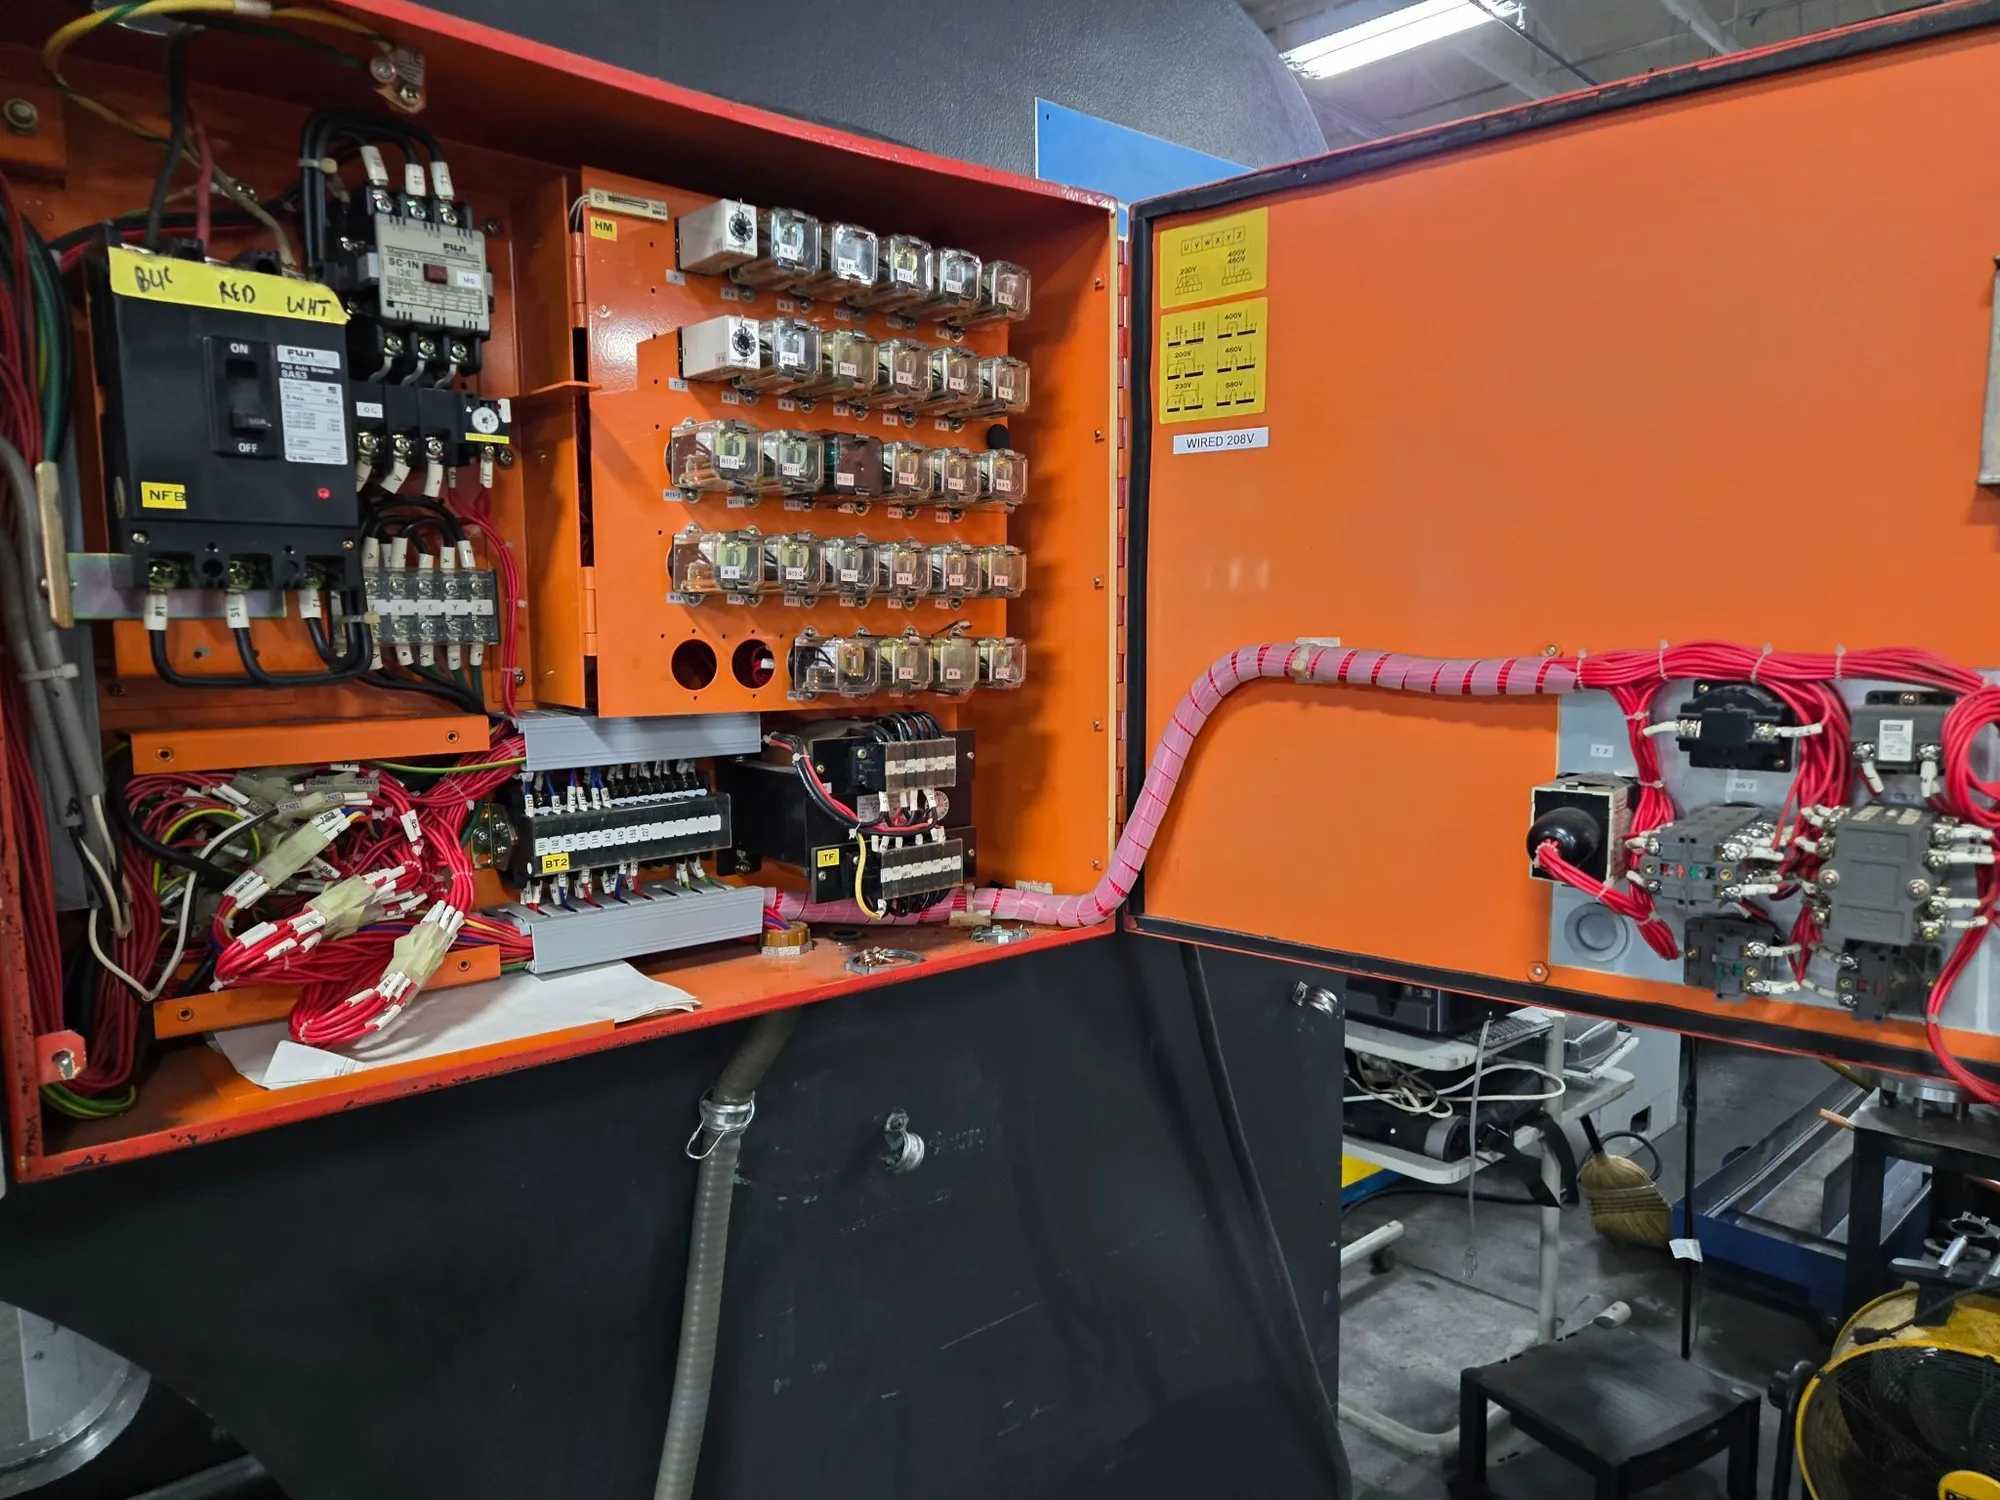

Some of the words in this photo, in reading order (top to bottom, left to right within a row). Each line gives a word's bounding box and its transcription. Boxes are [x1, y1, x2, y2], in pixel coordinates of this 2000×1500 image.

[594, 221, 613, 232] HM
[218, 280, 257, 304] RED
[286, 296, 332, 317] WHT
[230, 343, 249, 354] ON
[1186, 437, 1224, 449] WIRED
[1227, 433, 1255, 446] 208V
[238, 443, 258, 454] OFF
[149, 490, 187, 503] NFB
[823, 853, 834, 861] TF
[545, 858, 568, 868] BT2
